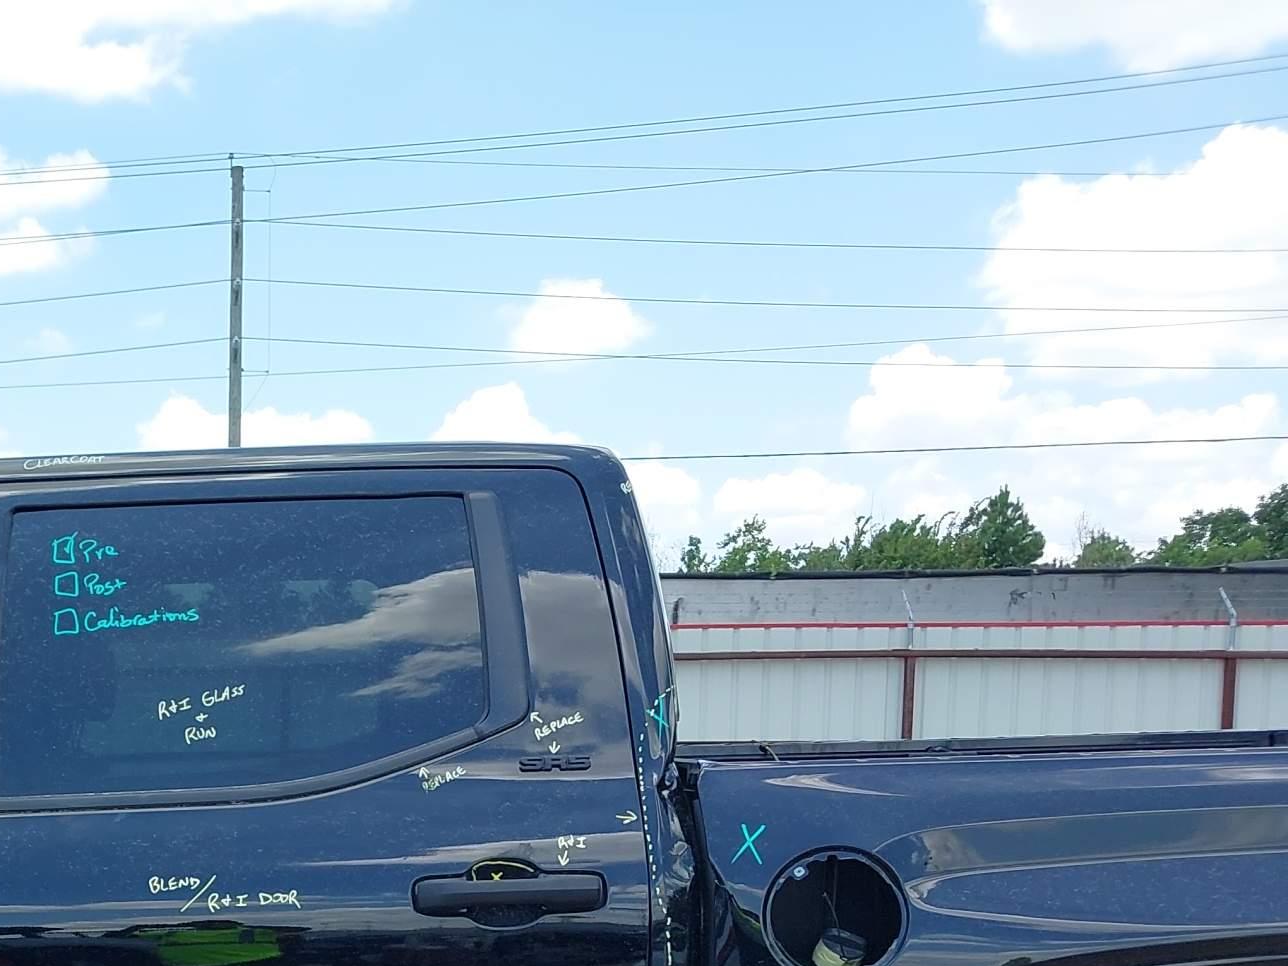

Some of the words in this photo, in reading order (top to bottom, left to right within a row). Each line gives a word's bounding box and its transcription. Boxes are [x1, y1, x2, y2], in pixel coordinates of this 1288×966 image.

[23, 456, 105, 470] CLEARCOAT
[79, 539, 119, 563] Pre
[84, 573, 127, 595] Post
[84, 606, 199, 632] Calibrations
[201, 684, 246, 706] GLASS
[184, 726, 216, 745] RUN
[534, 711, 584, 741] REPLACE
[519, 755, 592, 773] SR5
[422, 765, 467, 792] REPLACE
[258, 889, 302, 909] DOOR
